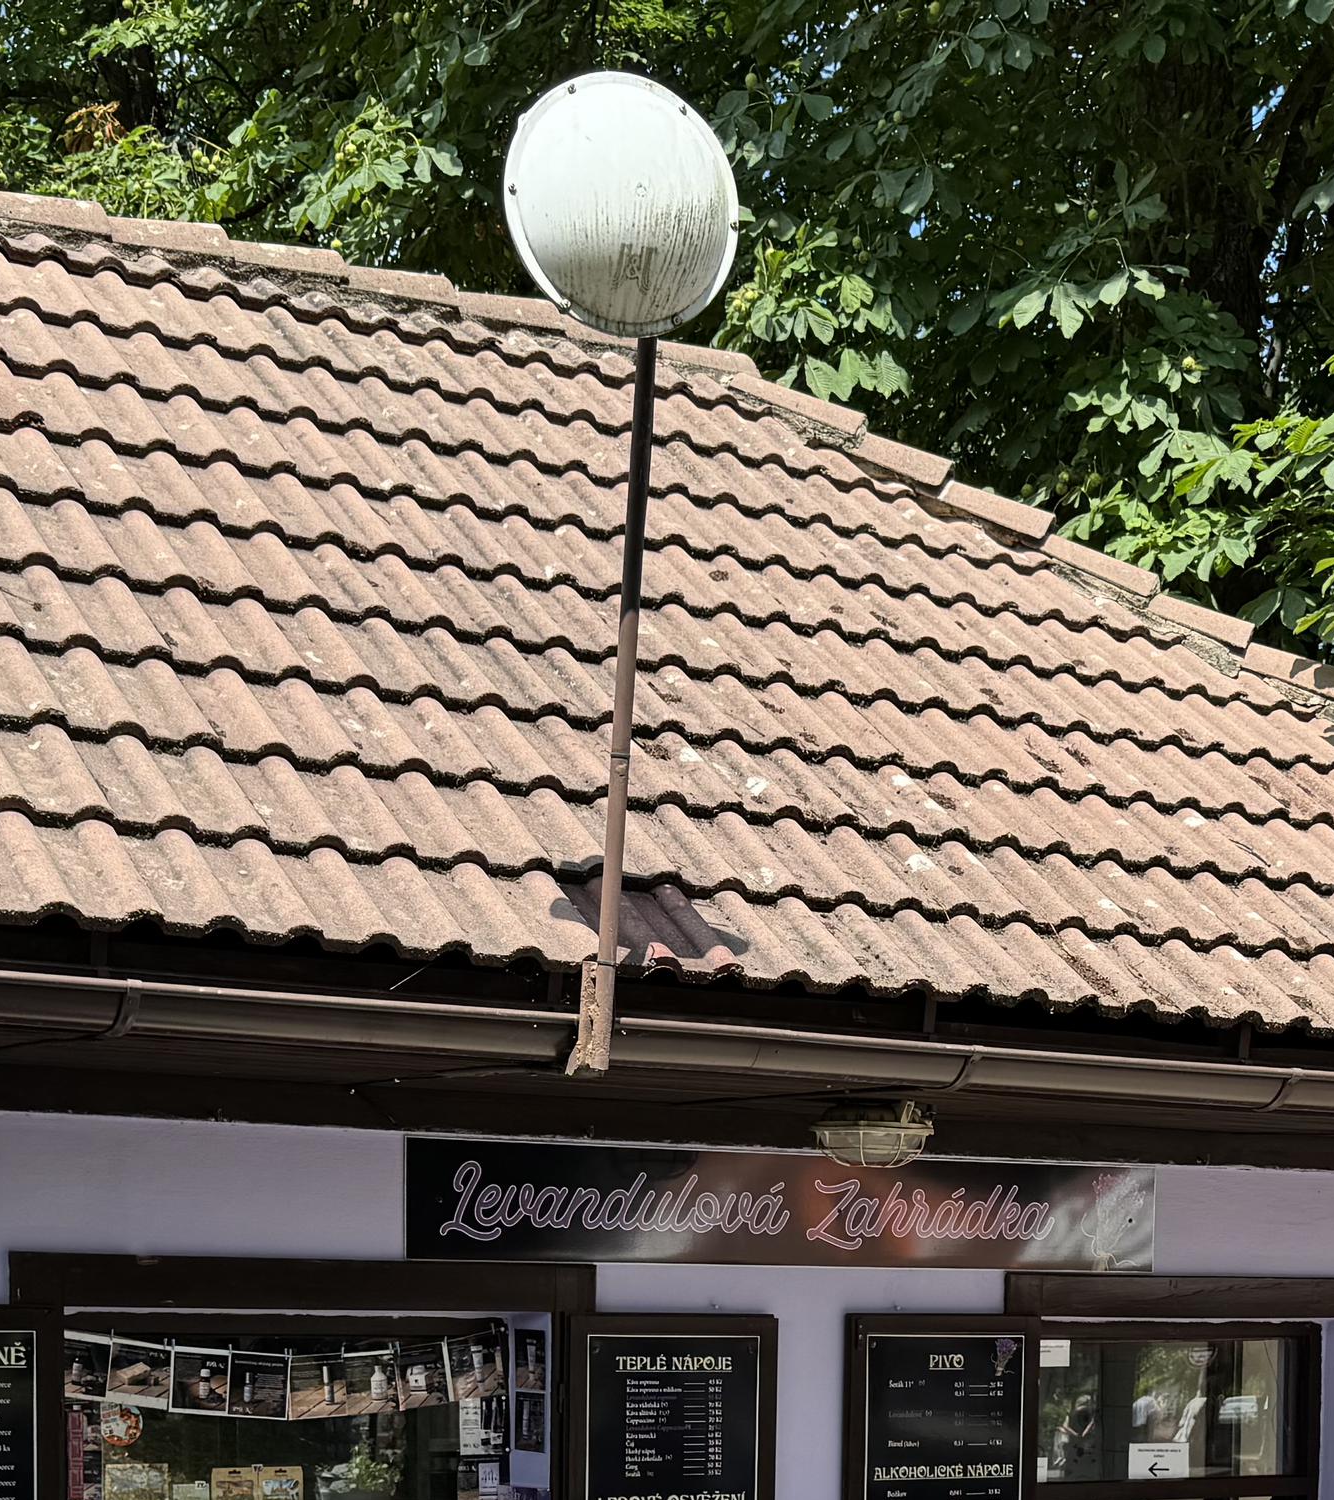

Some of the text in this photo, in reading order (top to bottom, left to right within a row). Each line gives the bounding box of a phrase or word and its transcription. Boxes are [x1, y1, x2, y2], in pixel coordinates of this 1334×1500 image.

[440, 1160, 1055, 1250] Levandulová Zahrádka
[615, 1354, 733, 1371] TEPLÉ NÁPOJE
[929, 1354, 965, 1369] PIVO
[874, 1462, 1014, 1480] ALKOHOLICKÉ NÁPOJE
